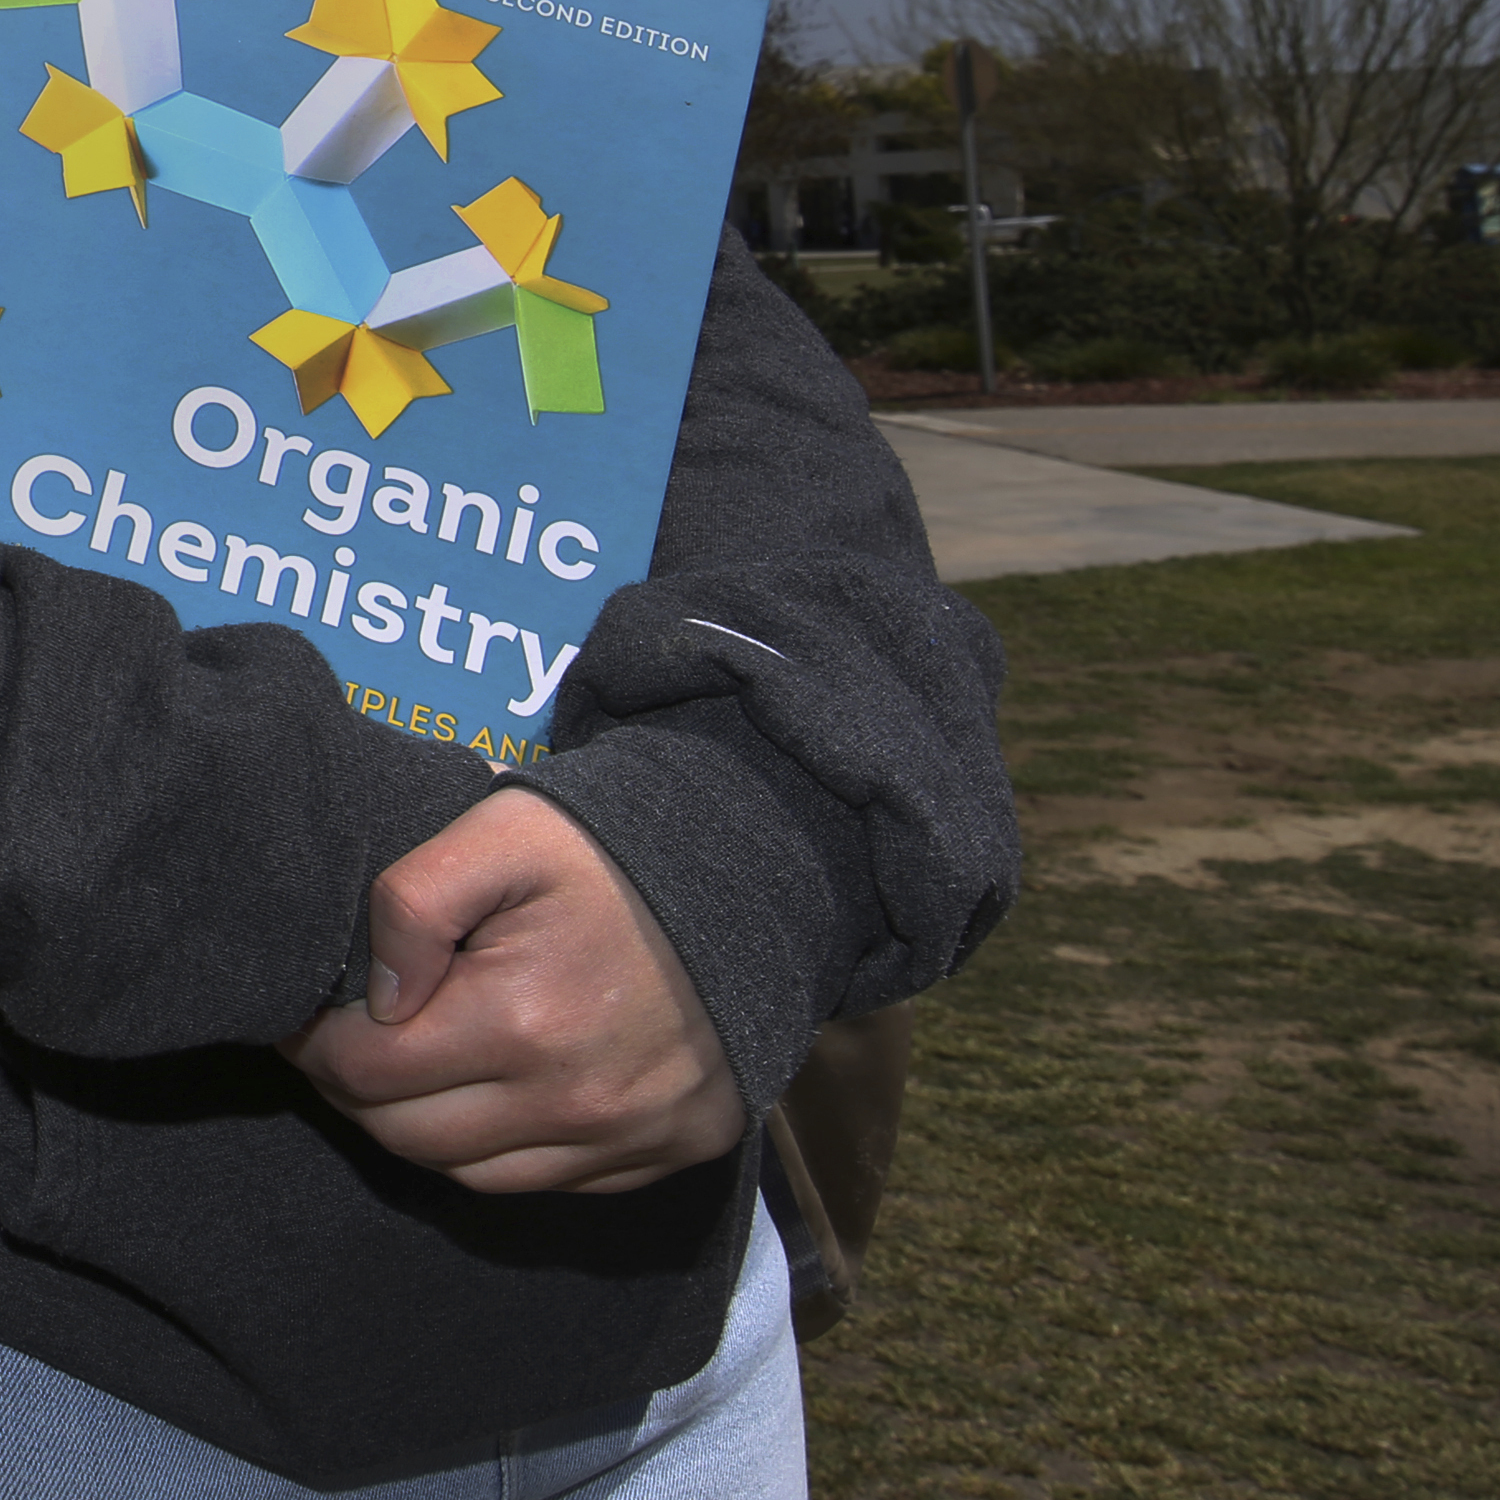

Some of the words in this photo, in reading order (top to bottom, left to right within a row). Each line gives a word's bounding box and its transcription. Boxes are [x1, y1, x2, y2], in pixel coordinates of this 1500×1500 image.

[600, 16, 710, 62] EDITION
[171, 385, 600, 581] Organic
[10, 453, 581, 718] Chemistry
[345, 681, 457, 741] IPLES
